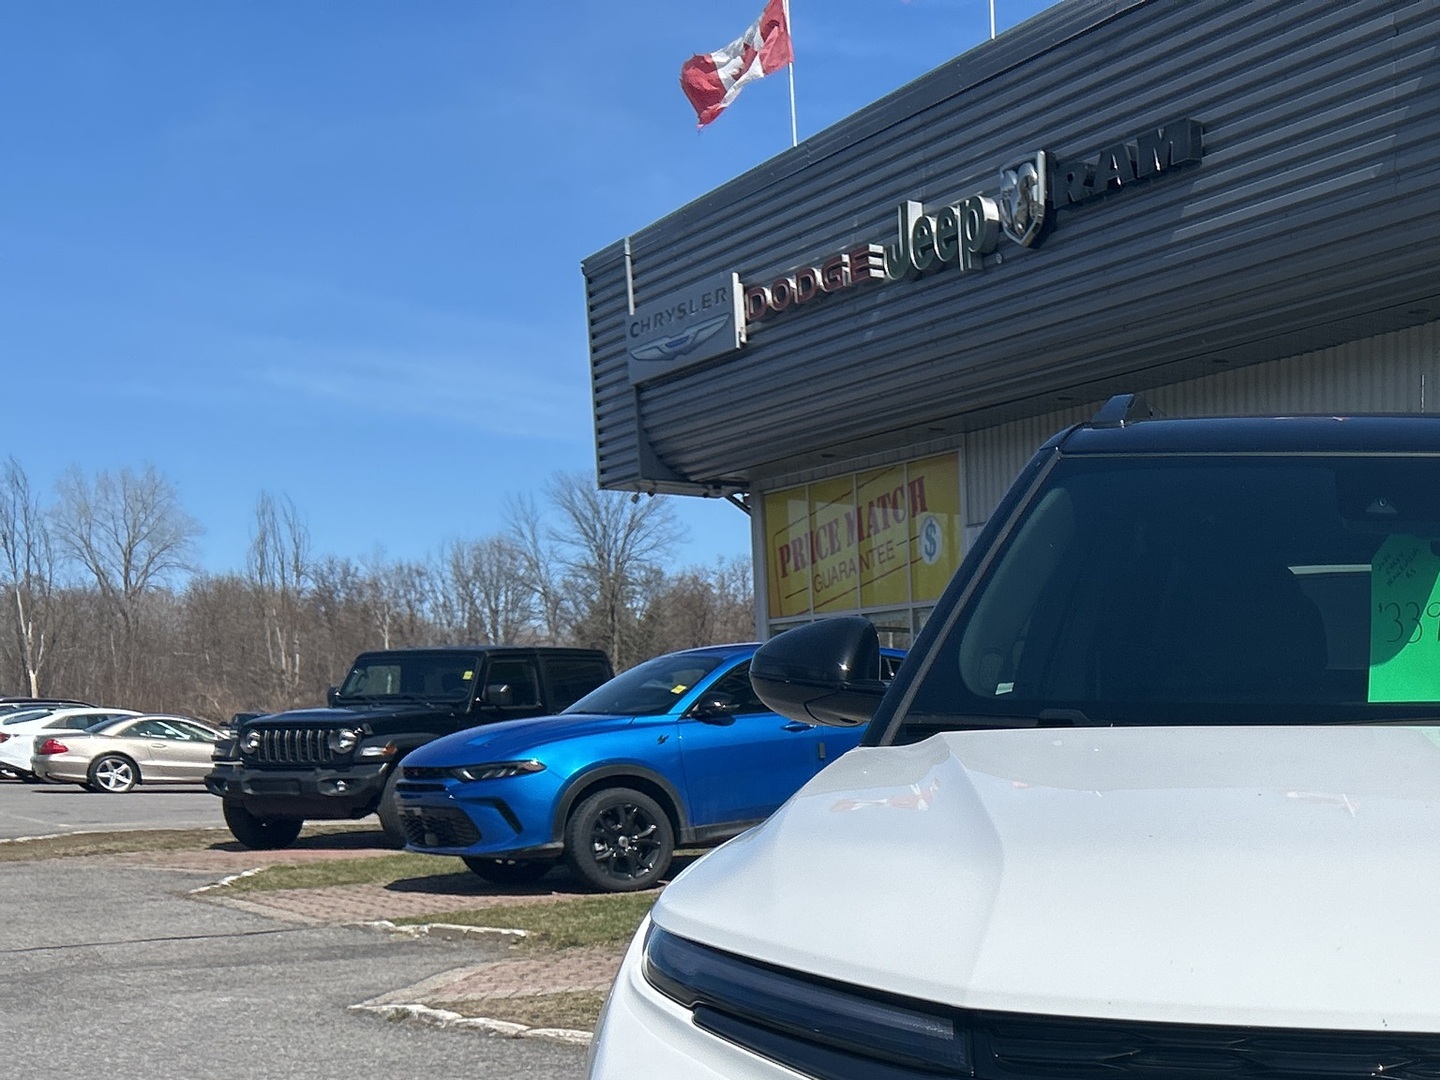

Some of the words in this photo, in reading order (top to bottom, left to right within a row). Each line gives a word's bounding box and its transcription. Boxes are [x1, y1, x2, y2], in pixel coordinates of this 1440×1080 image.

[1053, 118, 1202, 209] RAM
[884, 195, 999, 281] Jeep
[630, 287, 728, 338] CHRYSLER
[746, 244, 884, 320] DODGE
[778, 515, 841, 579] PRICE
[844, 475, 928, 550] MATCH
[813, 539, 896, 594] GUARANTEE
